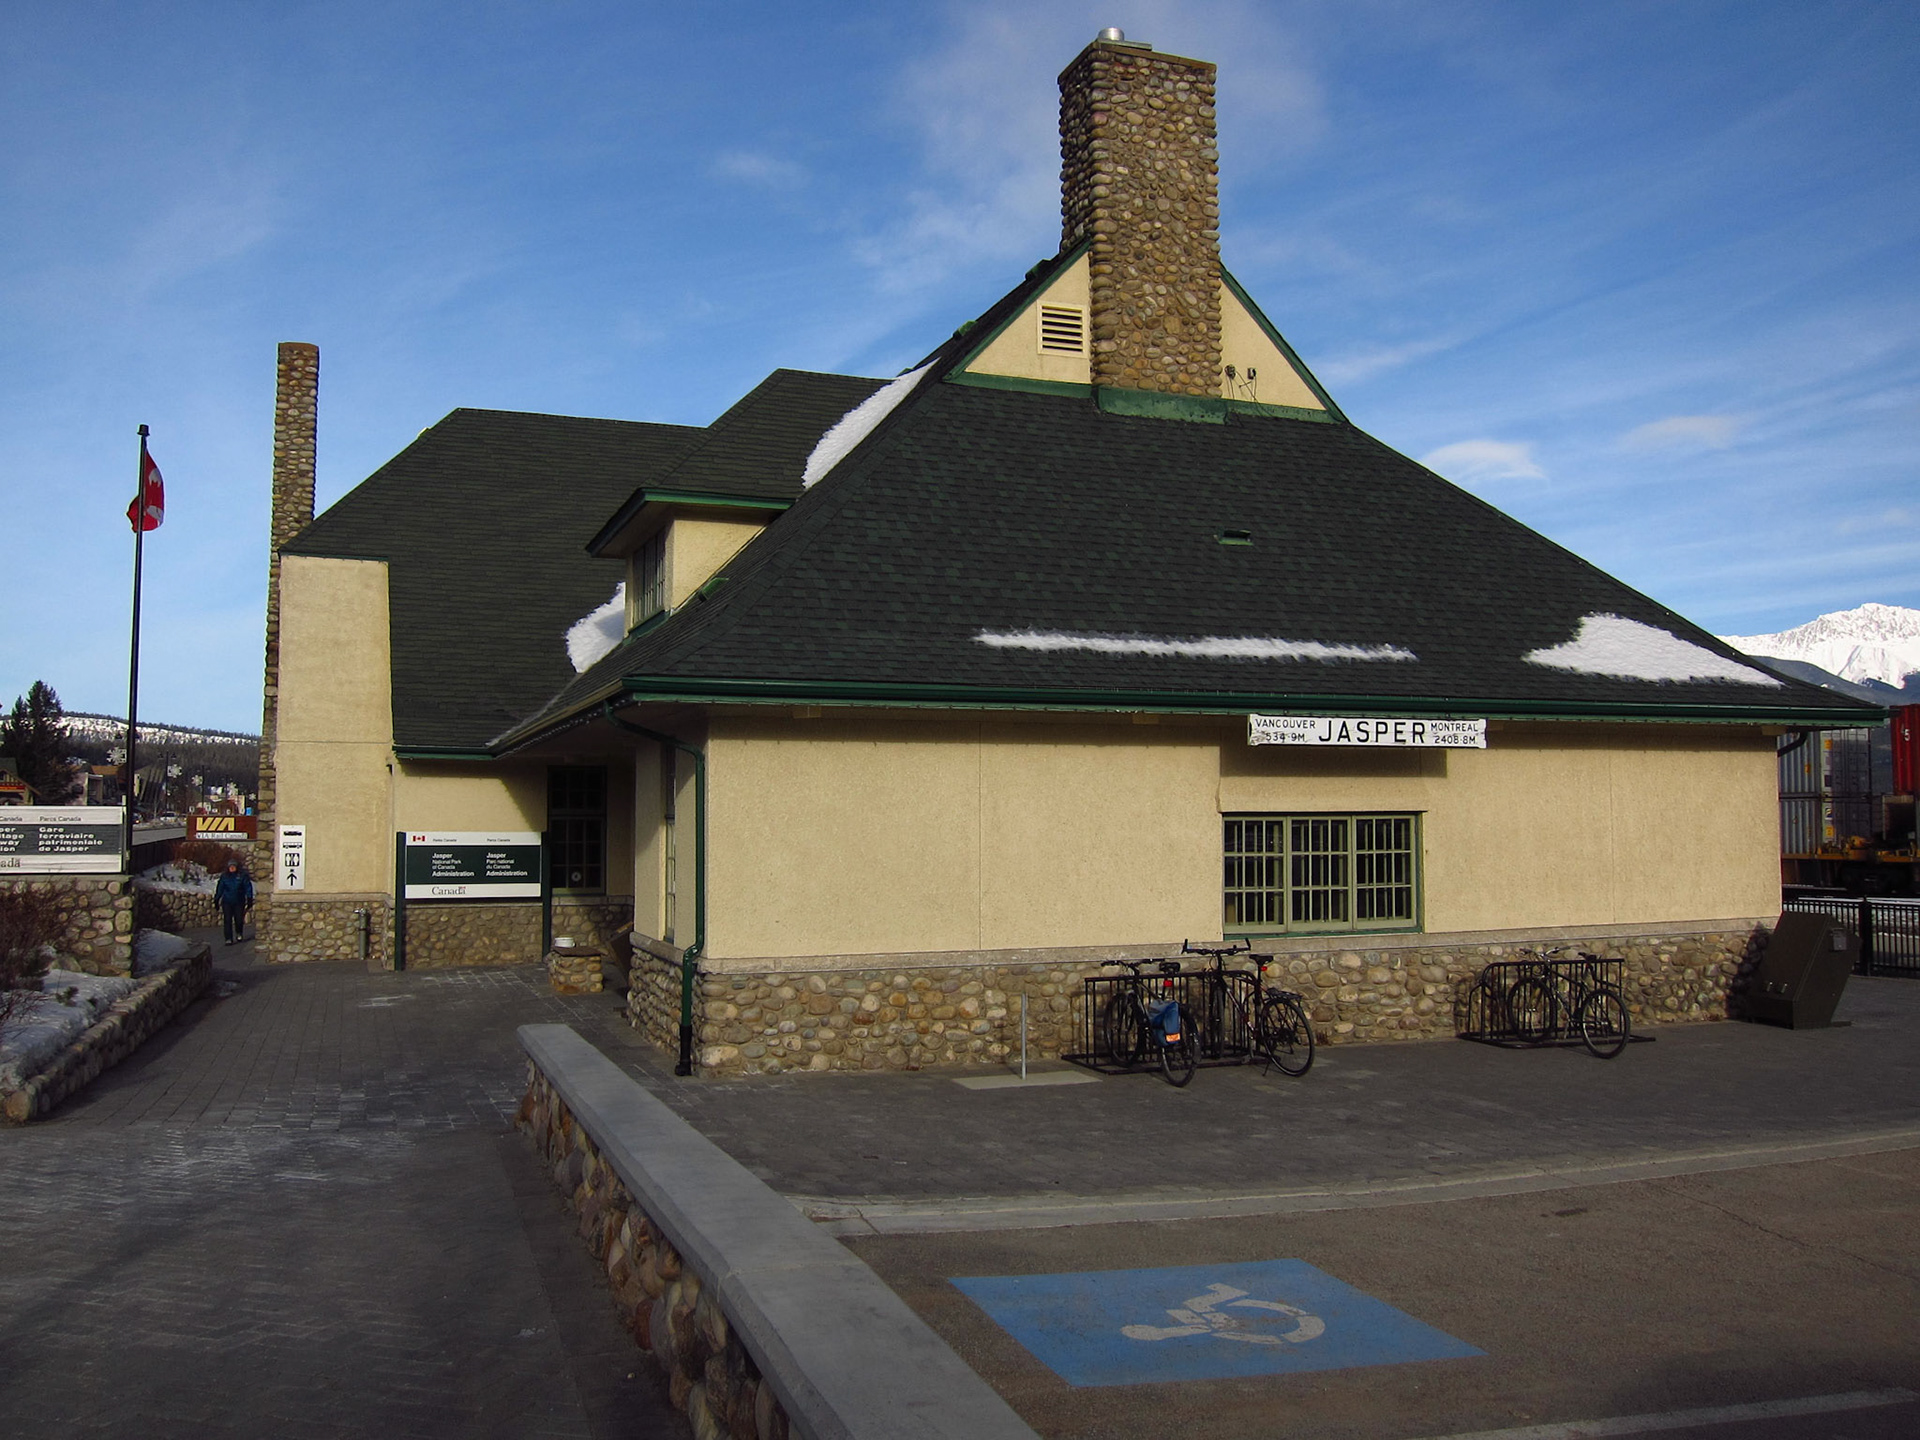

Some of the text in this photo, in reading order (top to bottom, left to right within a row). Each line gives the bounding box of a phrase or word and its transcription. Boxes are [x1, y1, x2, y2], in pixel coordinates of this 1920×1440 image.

[1255, 719, 1316, 729] VANCOUVER
[1430, 722, 1478, 732] MONTREAL
[1318, 721, 1426, 744] JASPER
[196, 817, 235, 831] VIA
[432, 852, 453, 860] Jasper
[431, 886, 465, 895] Canada
